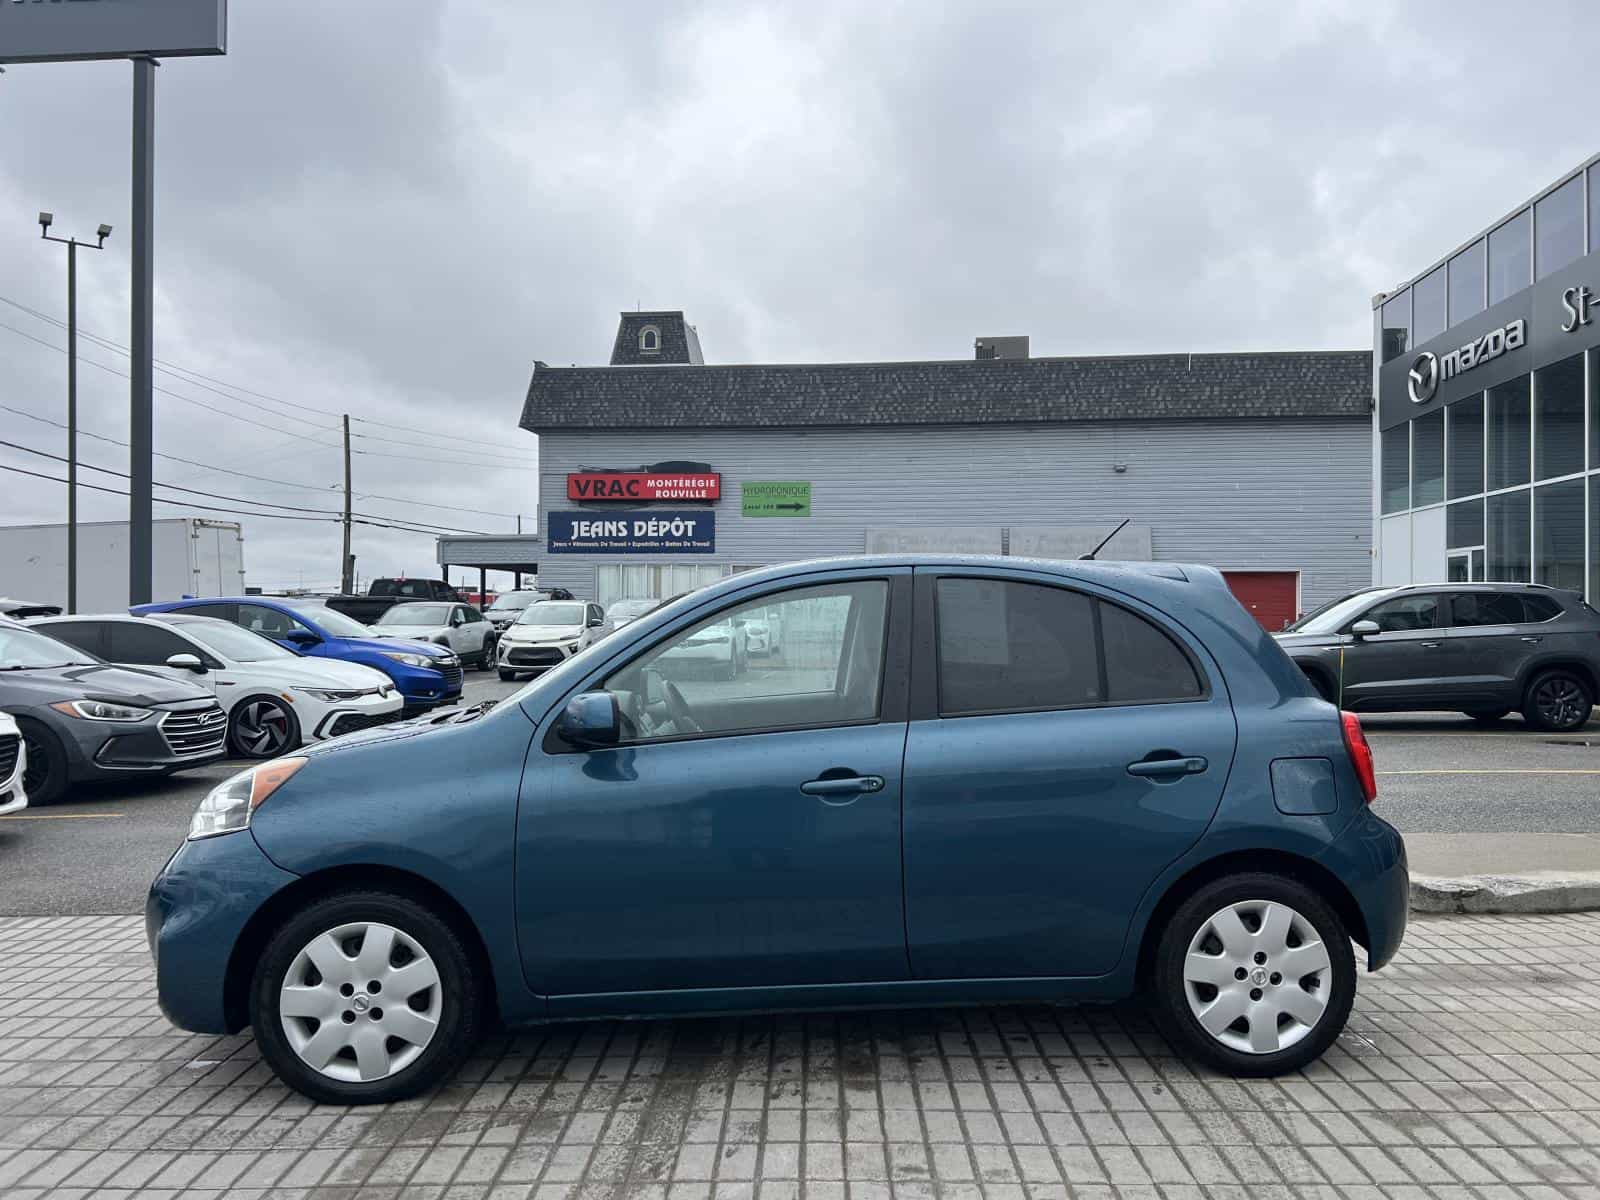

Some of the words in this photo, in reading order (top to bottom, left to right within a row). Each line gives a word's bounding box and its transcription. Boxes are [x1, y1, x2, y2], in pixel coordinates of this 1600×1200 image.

[574, 479, 640, 497] VRAC
[646, 476, 716, 488] MONTÉRÉGIE
[655, 489, 707, 498] ROUVILLE
[570, 520, 628, 540] JEANS
[633, 516, 696, 537] DÉPÔT
